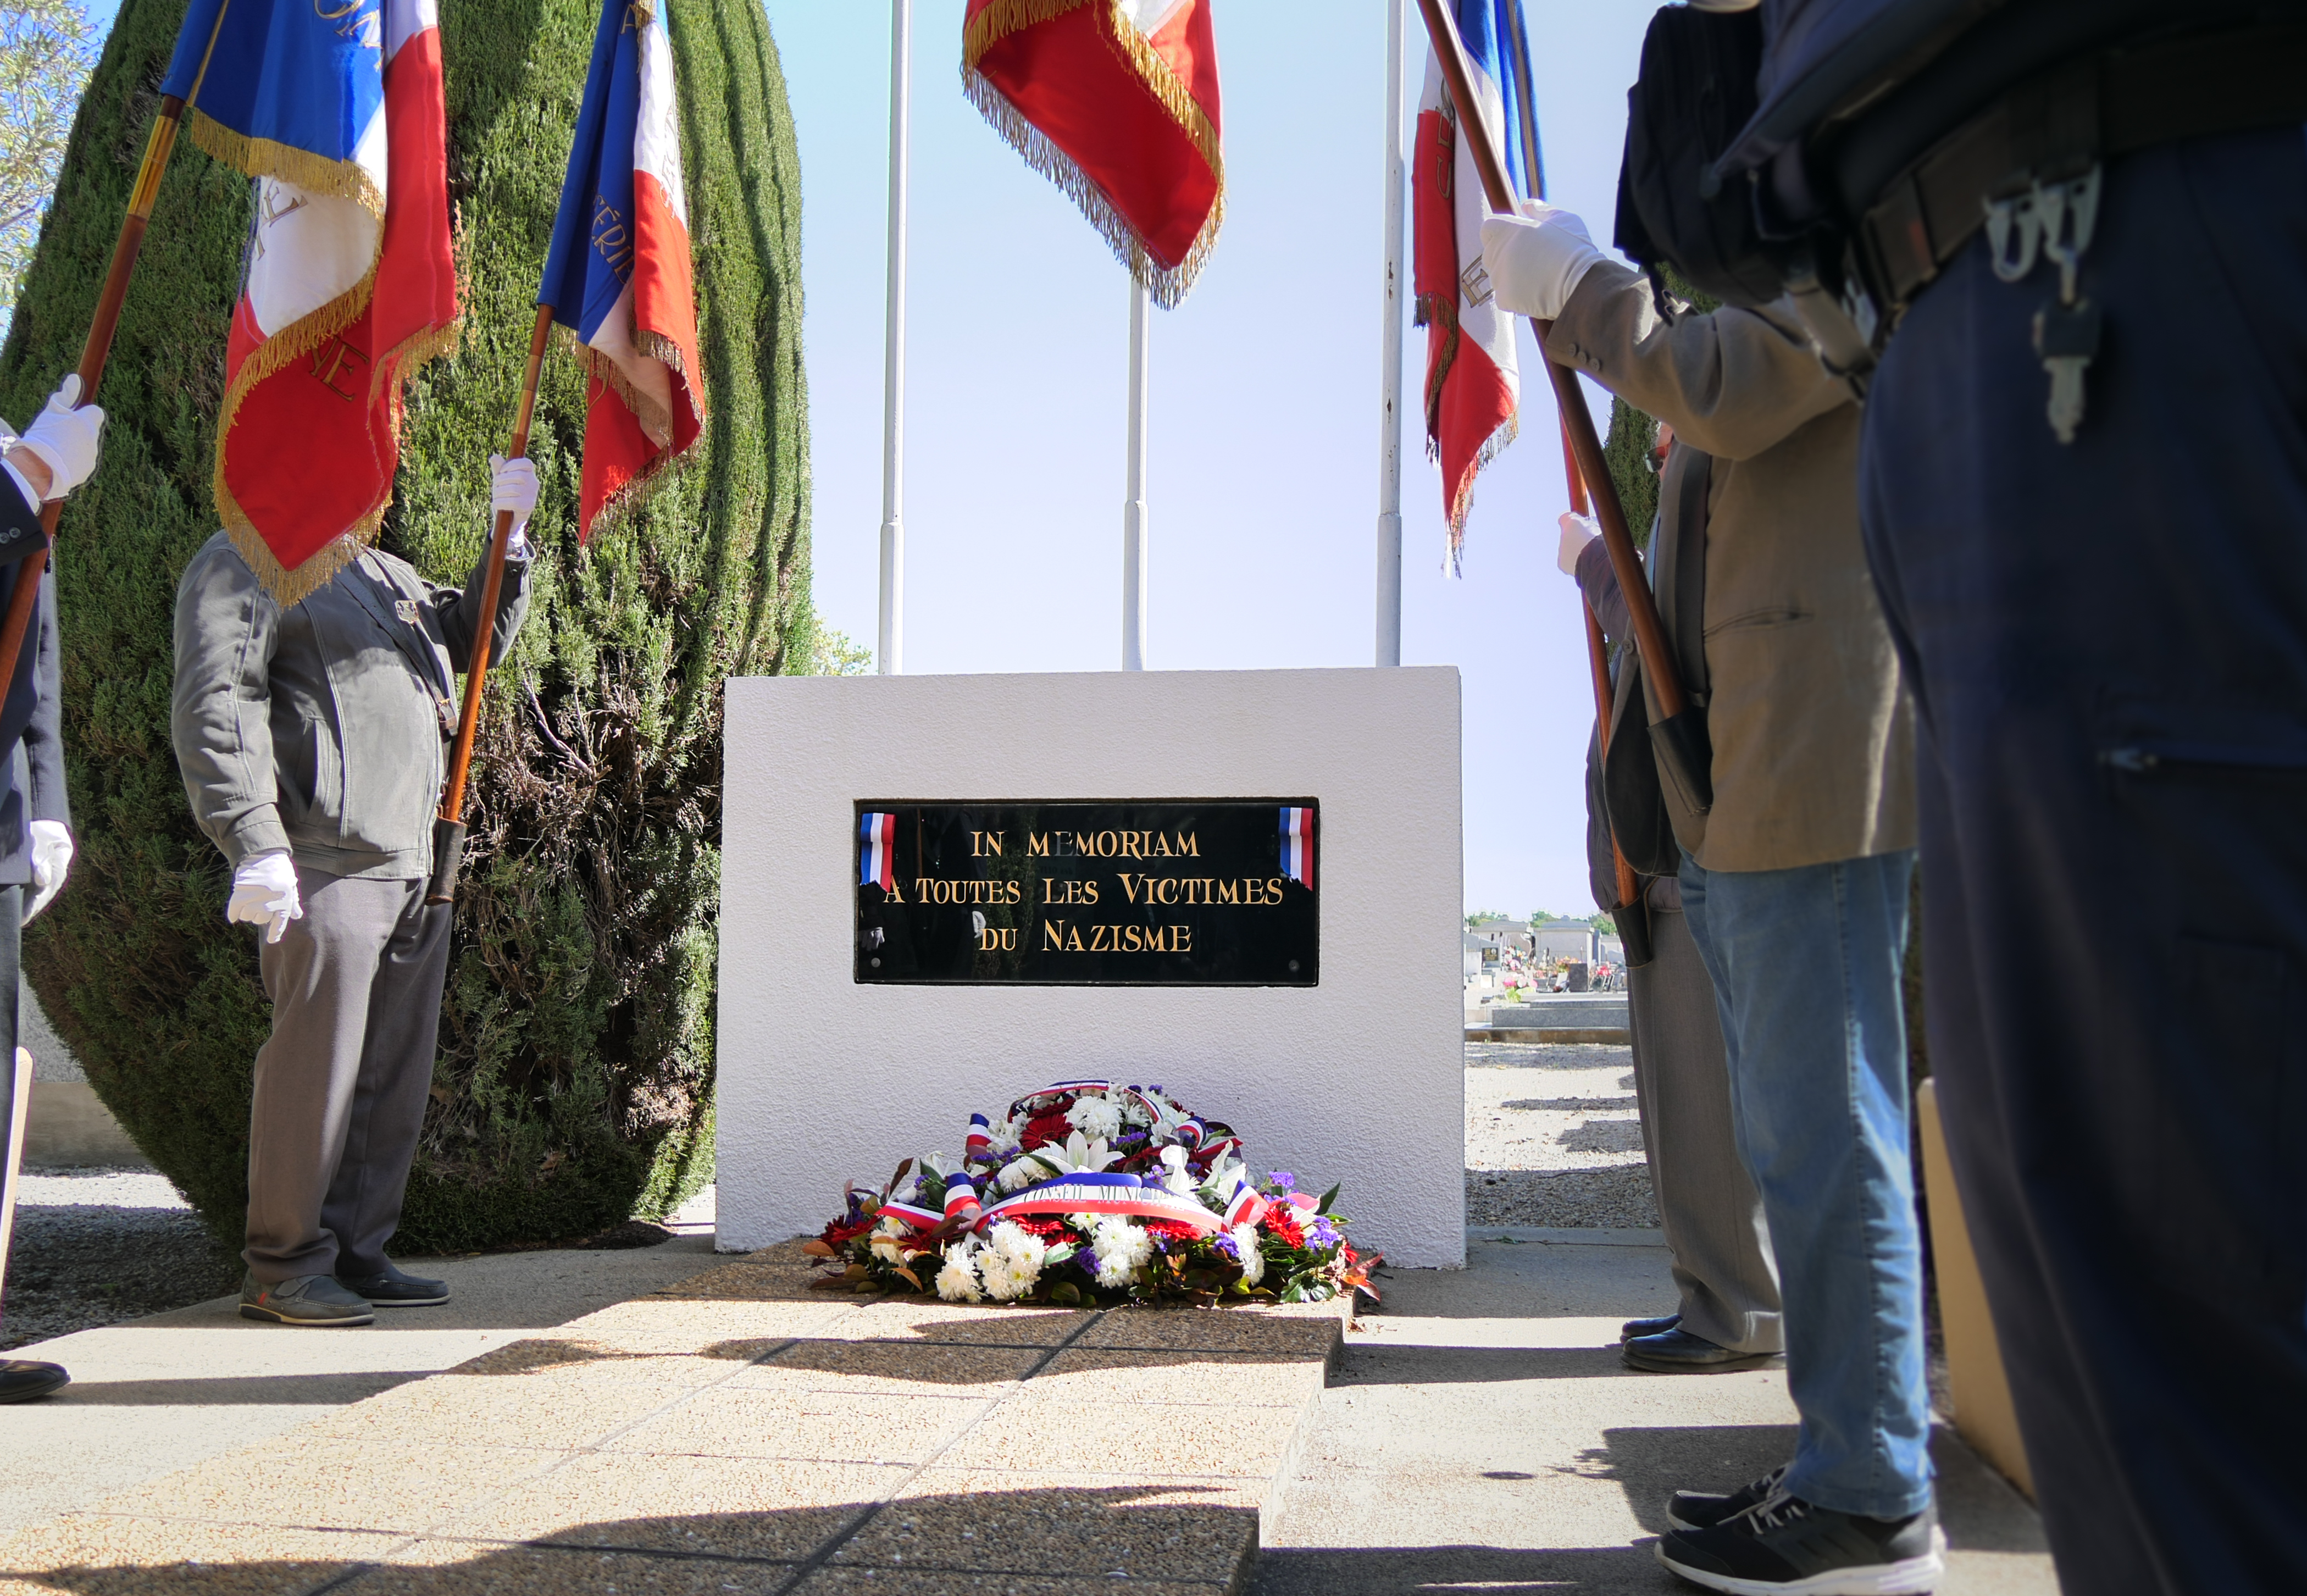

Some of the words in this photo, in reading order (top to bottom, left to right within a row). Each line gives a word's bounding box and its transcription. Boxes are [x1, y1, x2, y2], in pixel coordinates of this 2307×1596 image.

[970, 831, 1005, 857] IN
[1026, 830, 1201, 861] MEMORIAM
[883, 874, 906, 903] A
[915, 878, 1021, 904] TOUTES
[1042, 878, 1099, 905] LES
[1117, 873, 1283, 905] VICTIMES
[979, 928, 1018, 951] DU
[1041, 919, 1192, 952] NAZISME
[1023, 1183, 1087, 1203] CONSEIL
